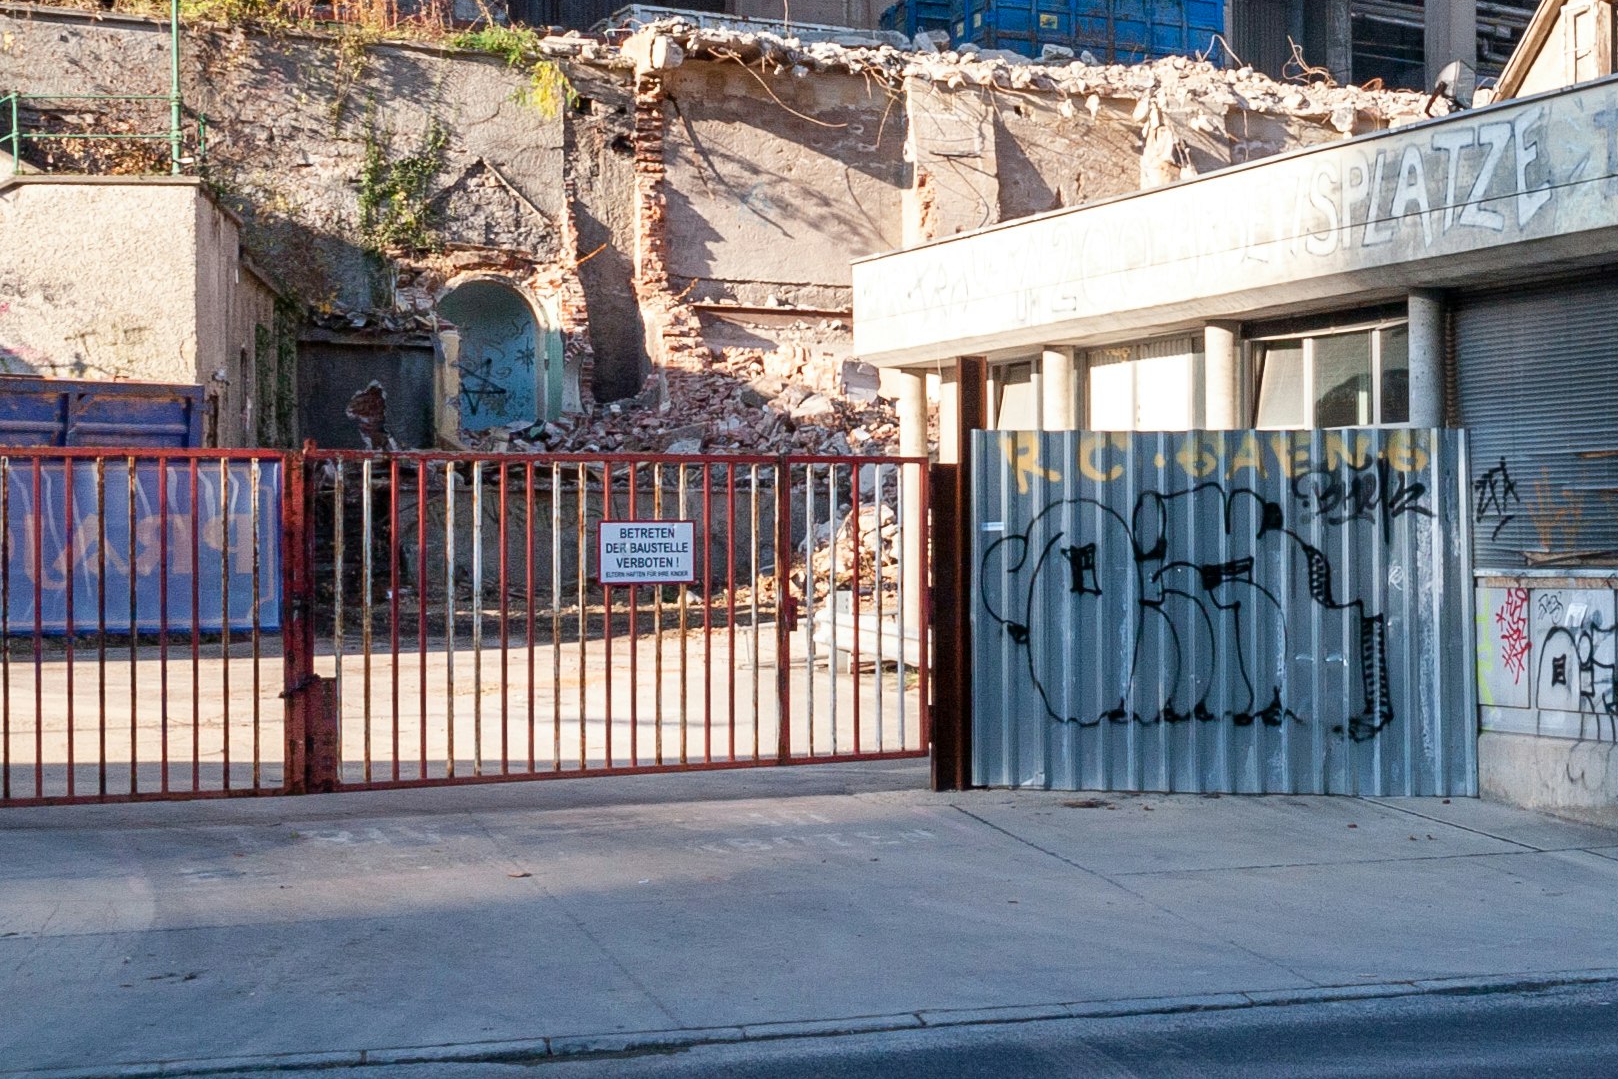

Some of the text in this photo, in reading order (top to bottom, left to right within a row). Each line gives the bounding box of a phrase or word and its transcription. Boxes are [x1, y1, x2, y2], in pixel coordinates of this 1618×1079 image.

[620, 527, 675, 539] BETRETEN
[605, 542, 688, 554] DER BAUSTELLE
[616, 557, 673, 568] VERBOTEN
